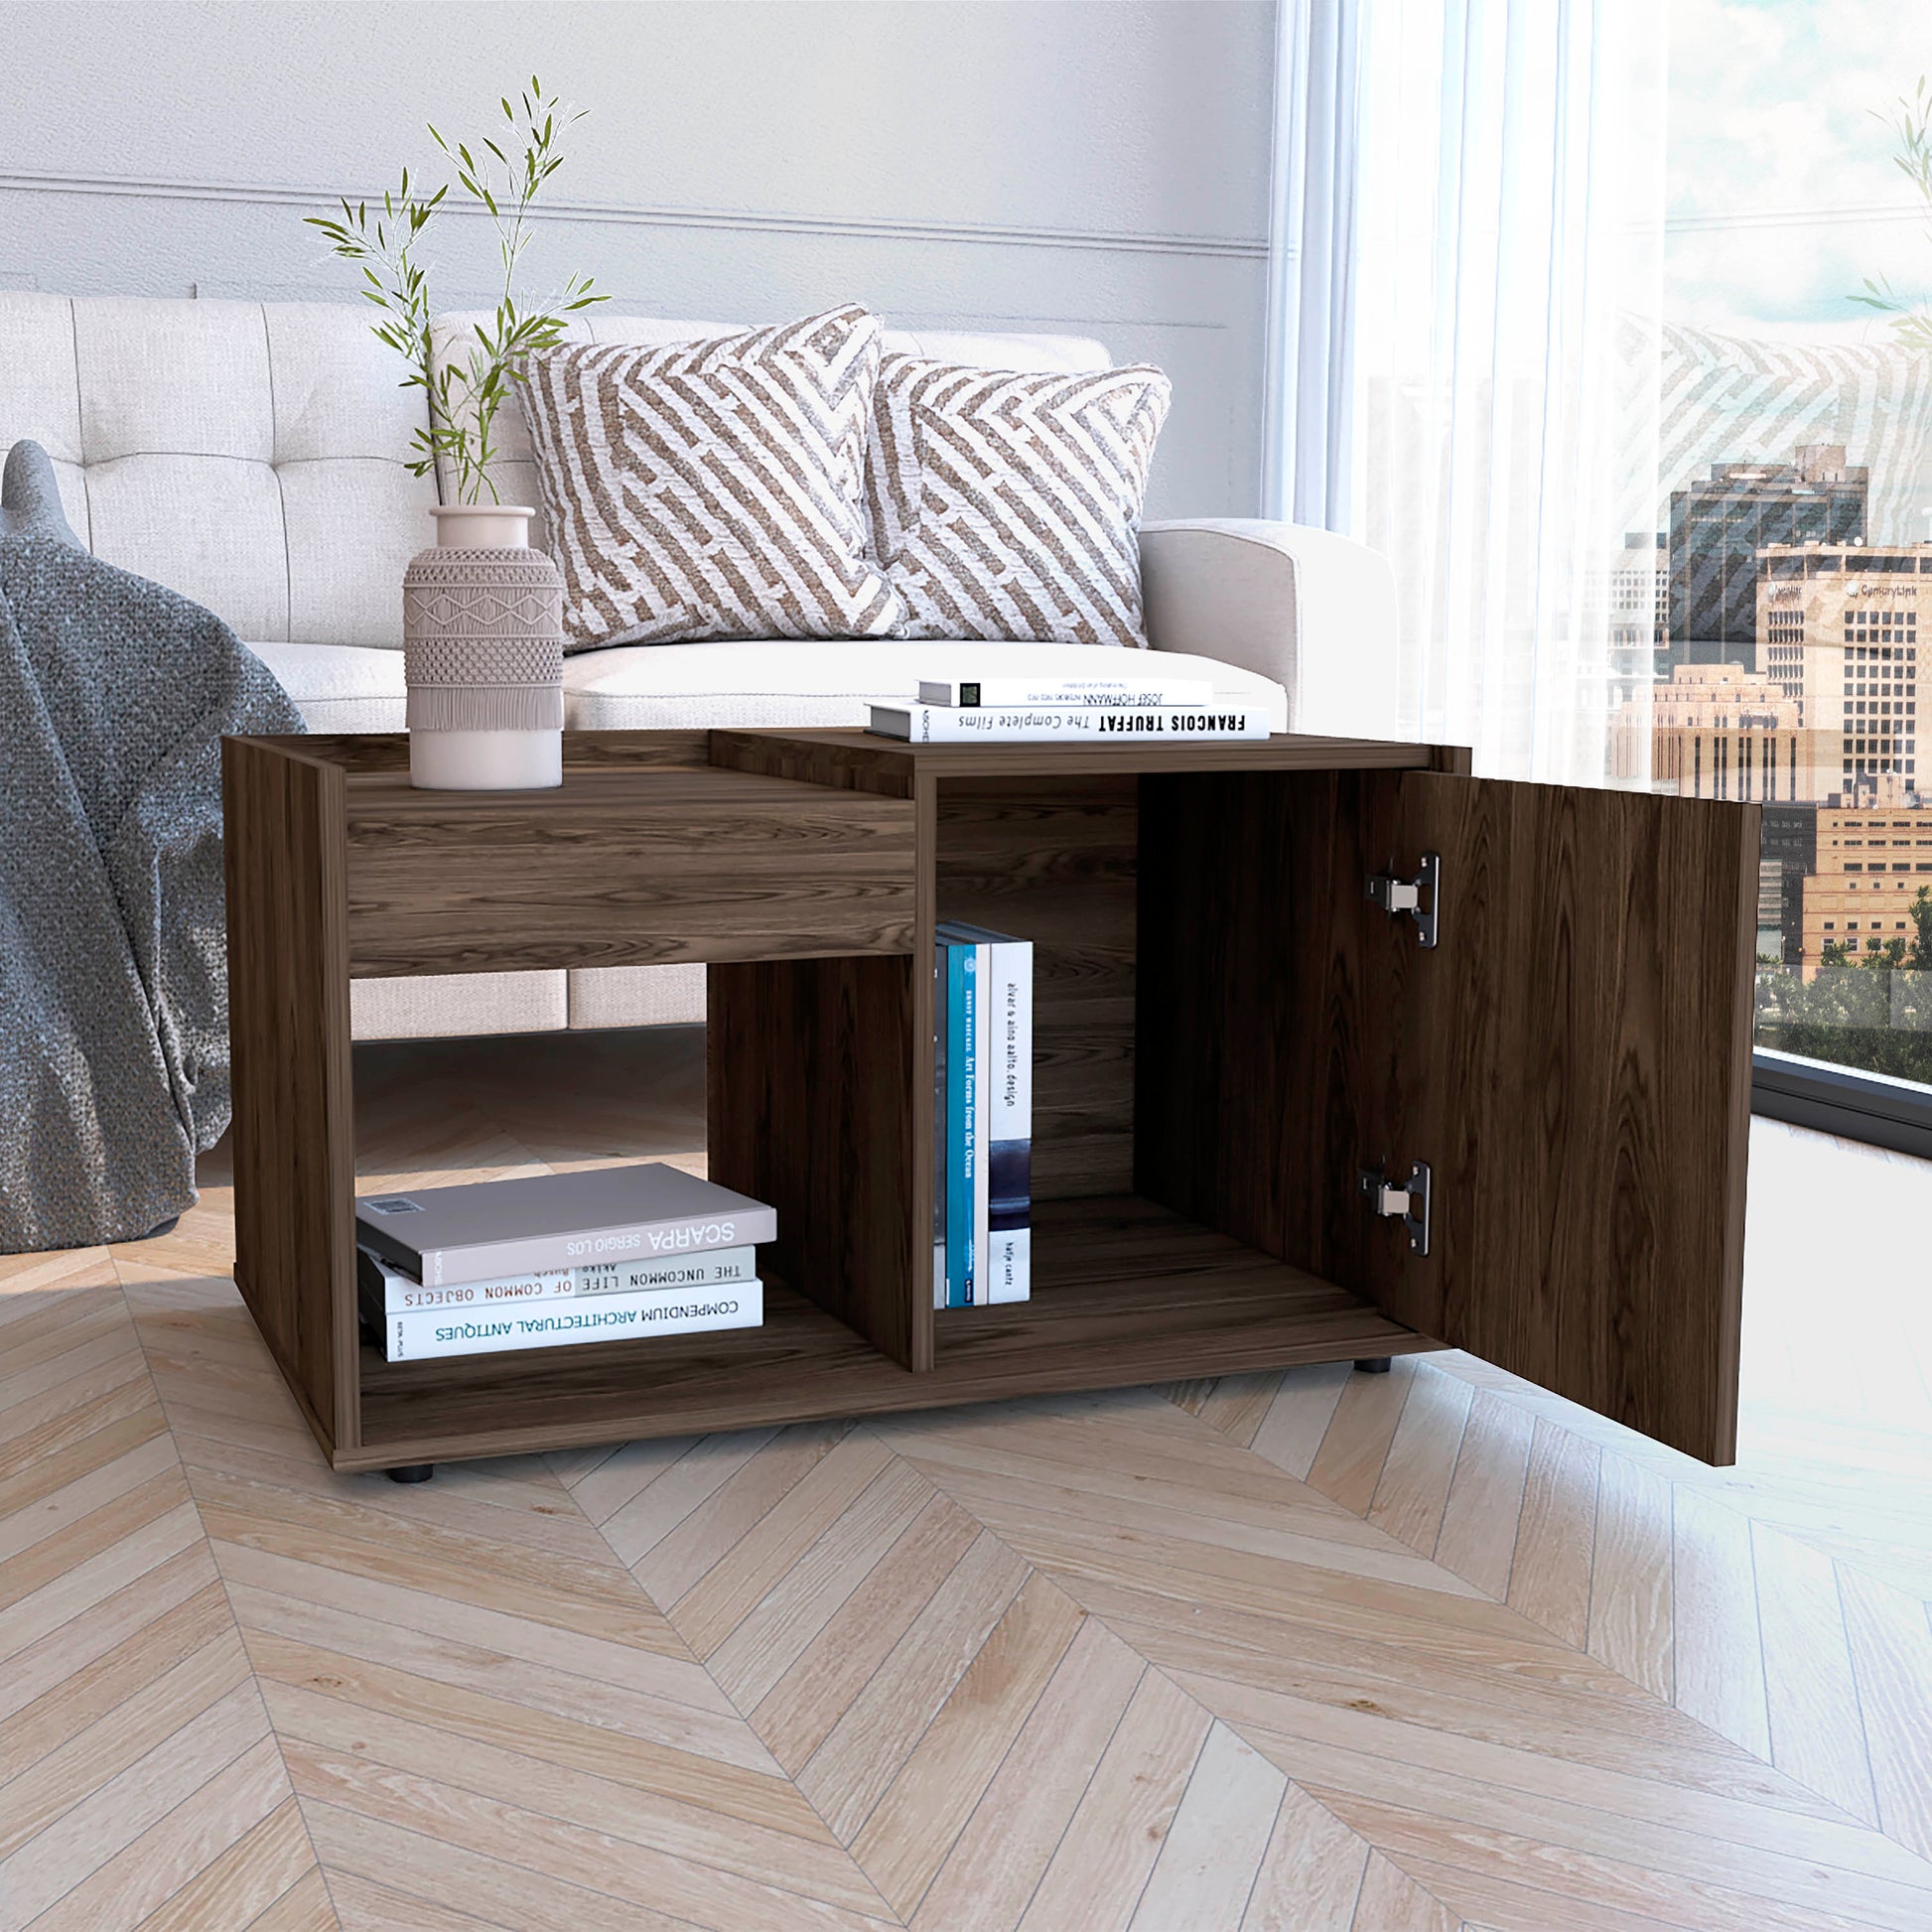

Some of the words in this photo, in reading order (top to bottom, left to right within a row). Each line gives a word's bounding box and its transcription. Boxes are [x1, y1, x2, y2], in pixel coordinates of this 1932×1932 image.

[1083, 693, 1136, 706] HOFFMANN
[1139, 693, 1163, 706] JOSEF
[959, 715, 993, 730] Films
[999, 713, 1061, 731] Complete
[1067, 715, 1090, 729] The
[1099, 715, 1164, 733] TRUFFAT
[1171, 715, 1246, 732] FRANCOIS
[1007, 983, 1019, 1008] alvar
[1007, 1021, 1019, 1041] aino
[965, 1056, 975, 1071] Art
[965, 1074, 974, 1104] Forms
[965, 1105, 975, 1130] from
[965, 1132, 975, 1146] the
[964, 1148, 975, 1178] Ocean
[597, 1232, 640, 1252] SERGIO
[649, 1222, 736, 1250] SCARPA
[567, 1240, 594, 1256] LOS
[582, 1263, 617, 1274] Akiko
[630, 1267, 705, 1287] UNCOMMON
[714, 1265, 742, 1279] THE
[484, 1282, 542, 1299] COMMON
[553, 1279, 572, 1294] OF
[582, 1275, 619, 1291] LIFE
[404, 1288, 474, 1307] OBJECTS
[641, 1301, 739, 1321] COMPENDIUM
[435, 1321, 512, 1341] ANTIQUES
[516, 1310, 636, 1334] ARCHITECTURAL
